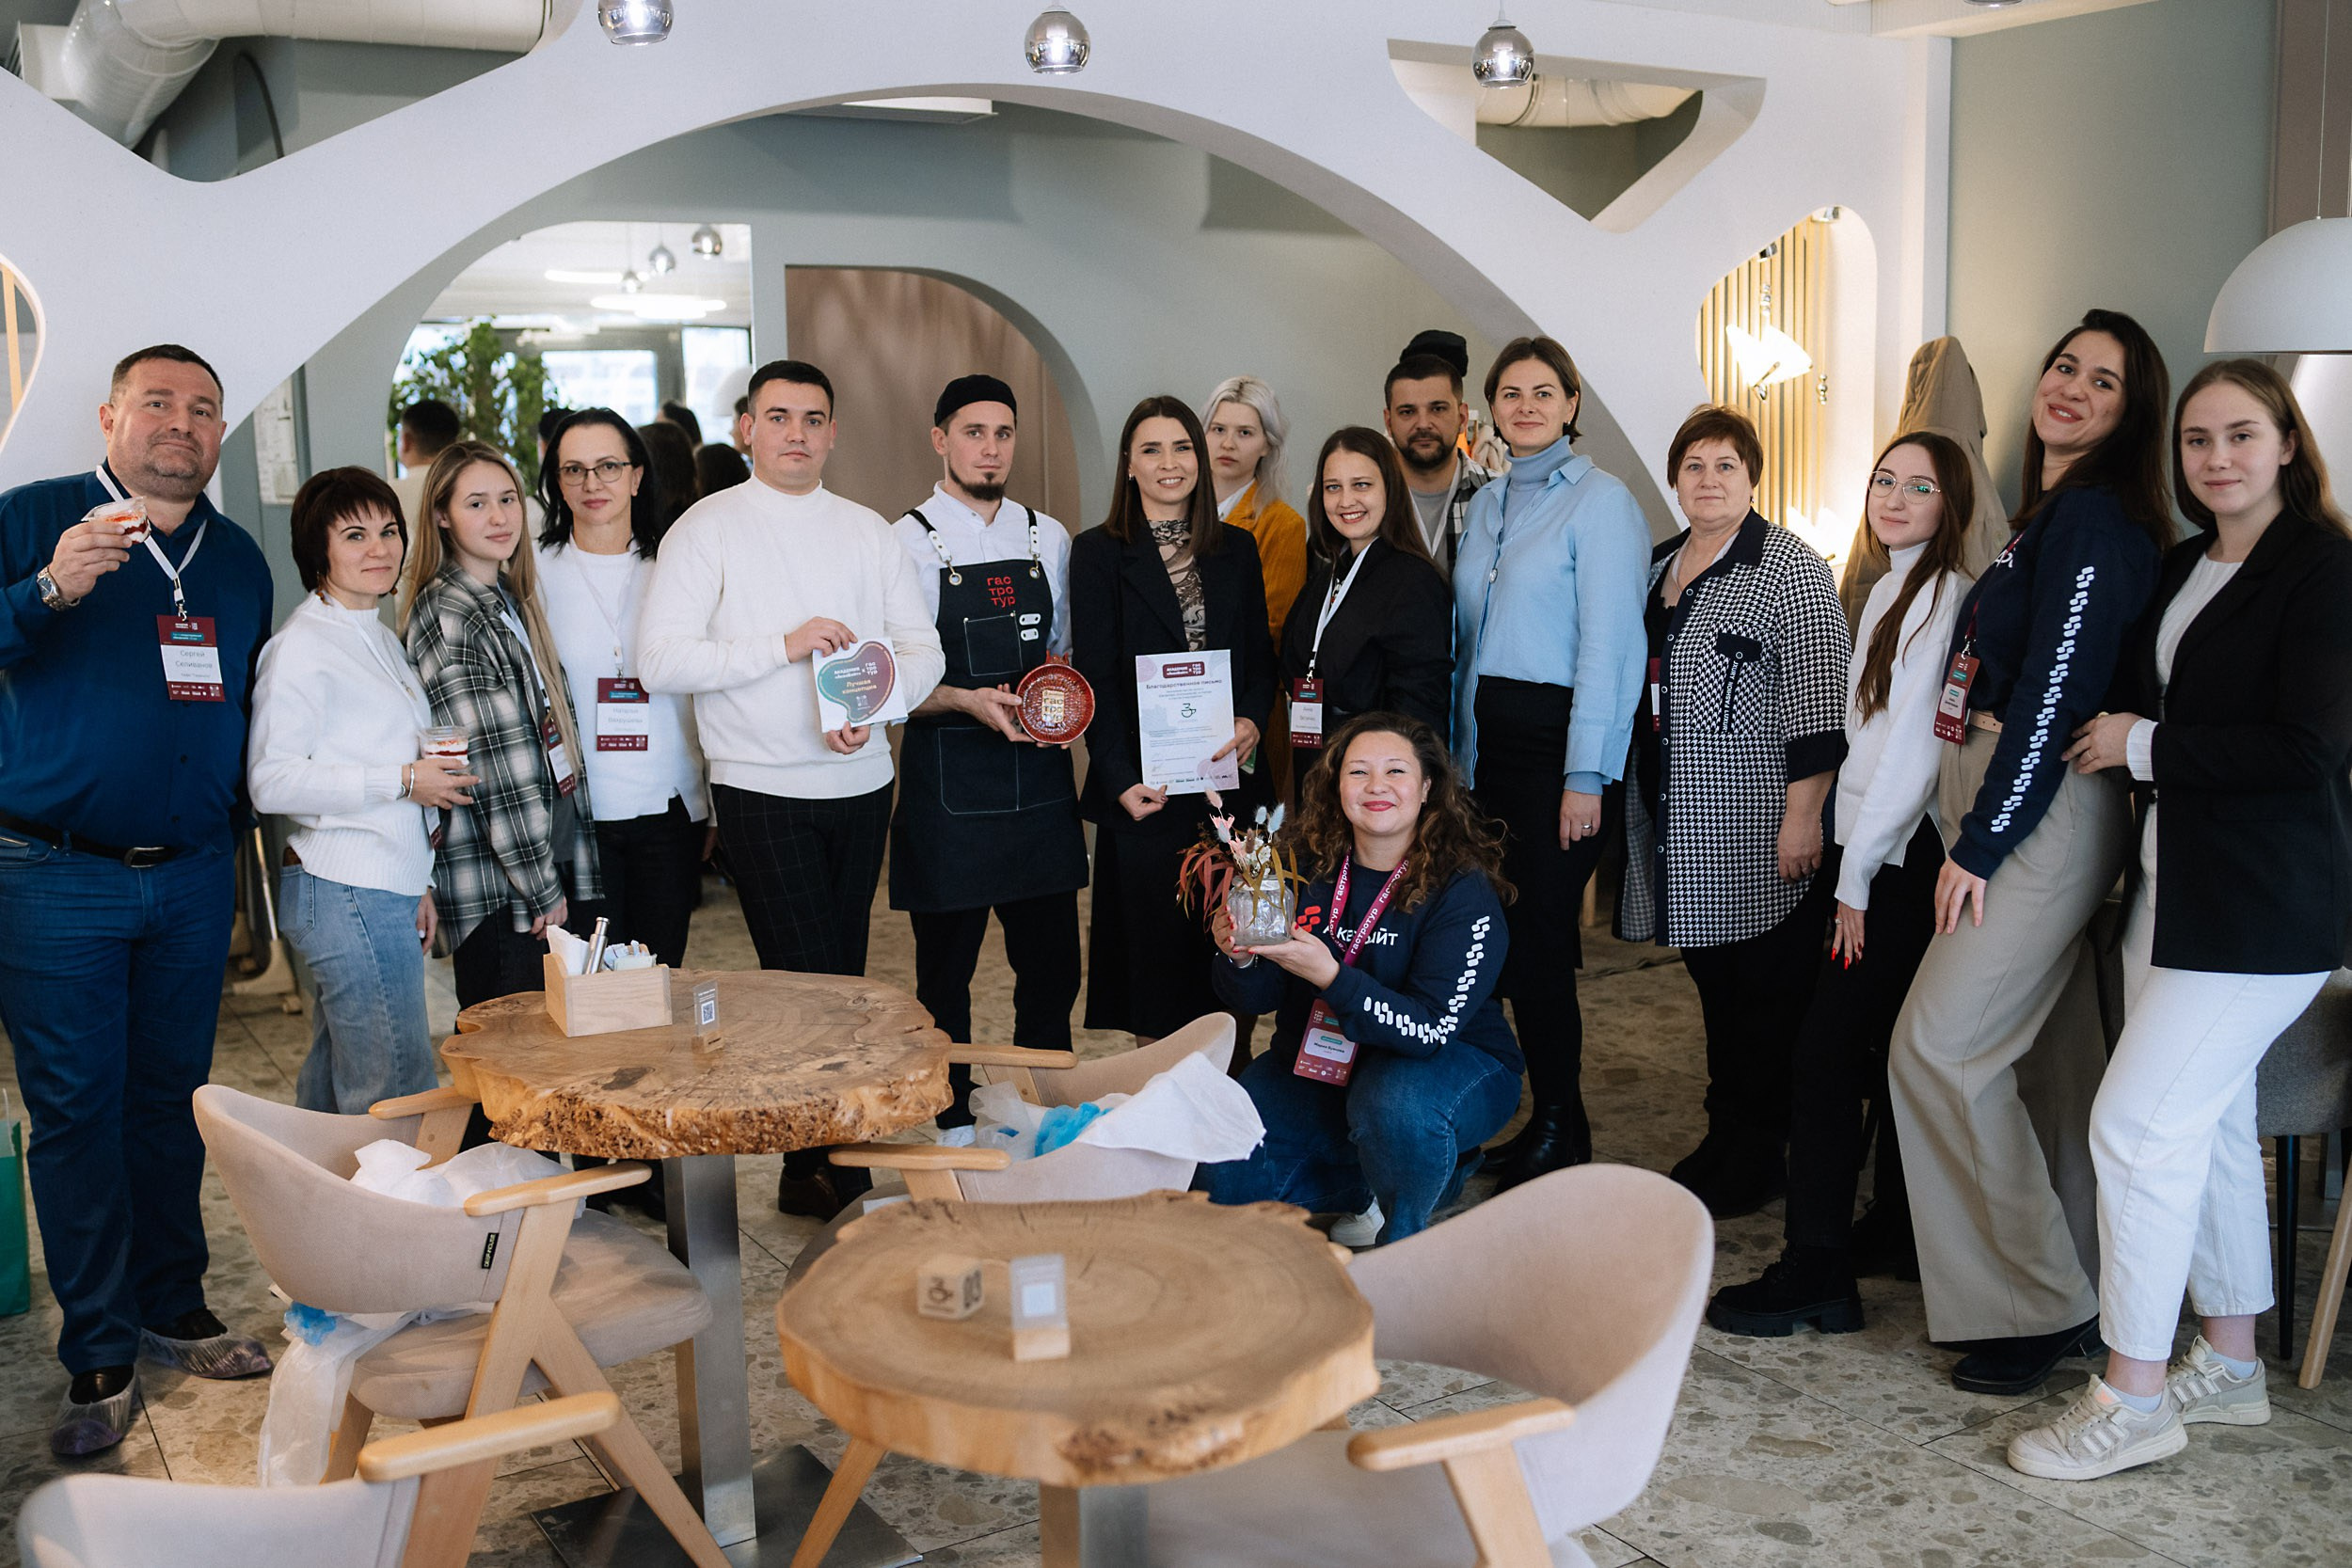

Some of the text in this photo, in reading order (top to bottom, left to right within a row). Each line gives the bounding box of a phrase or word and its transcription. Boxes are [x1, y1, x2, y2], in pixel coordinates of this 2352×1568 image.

[986, 576, 1011, 586] гас
[988, 586, 1014, 596] тро
[991, 596, 1016, 608] тур
[1146, 681, 1200, 689] Благодарственное
[1351, 908, 1378, 954] гастротур
